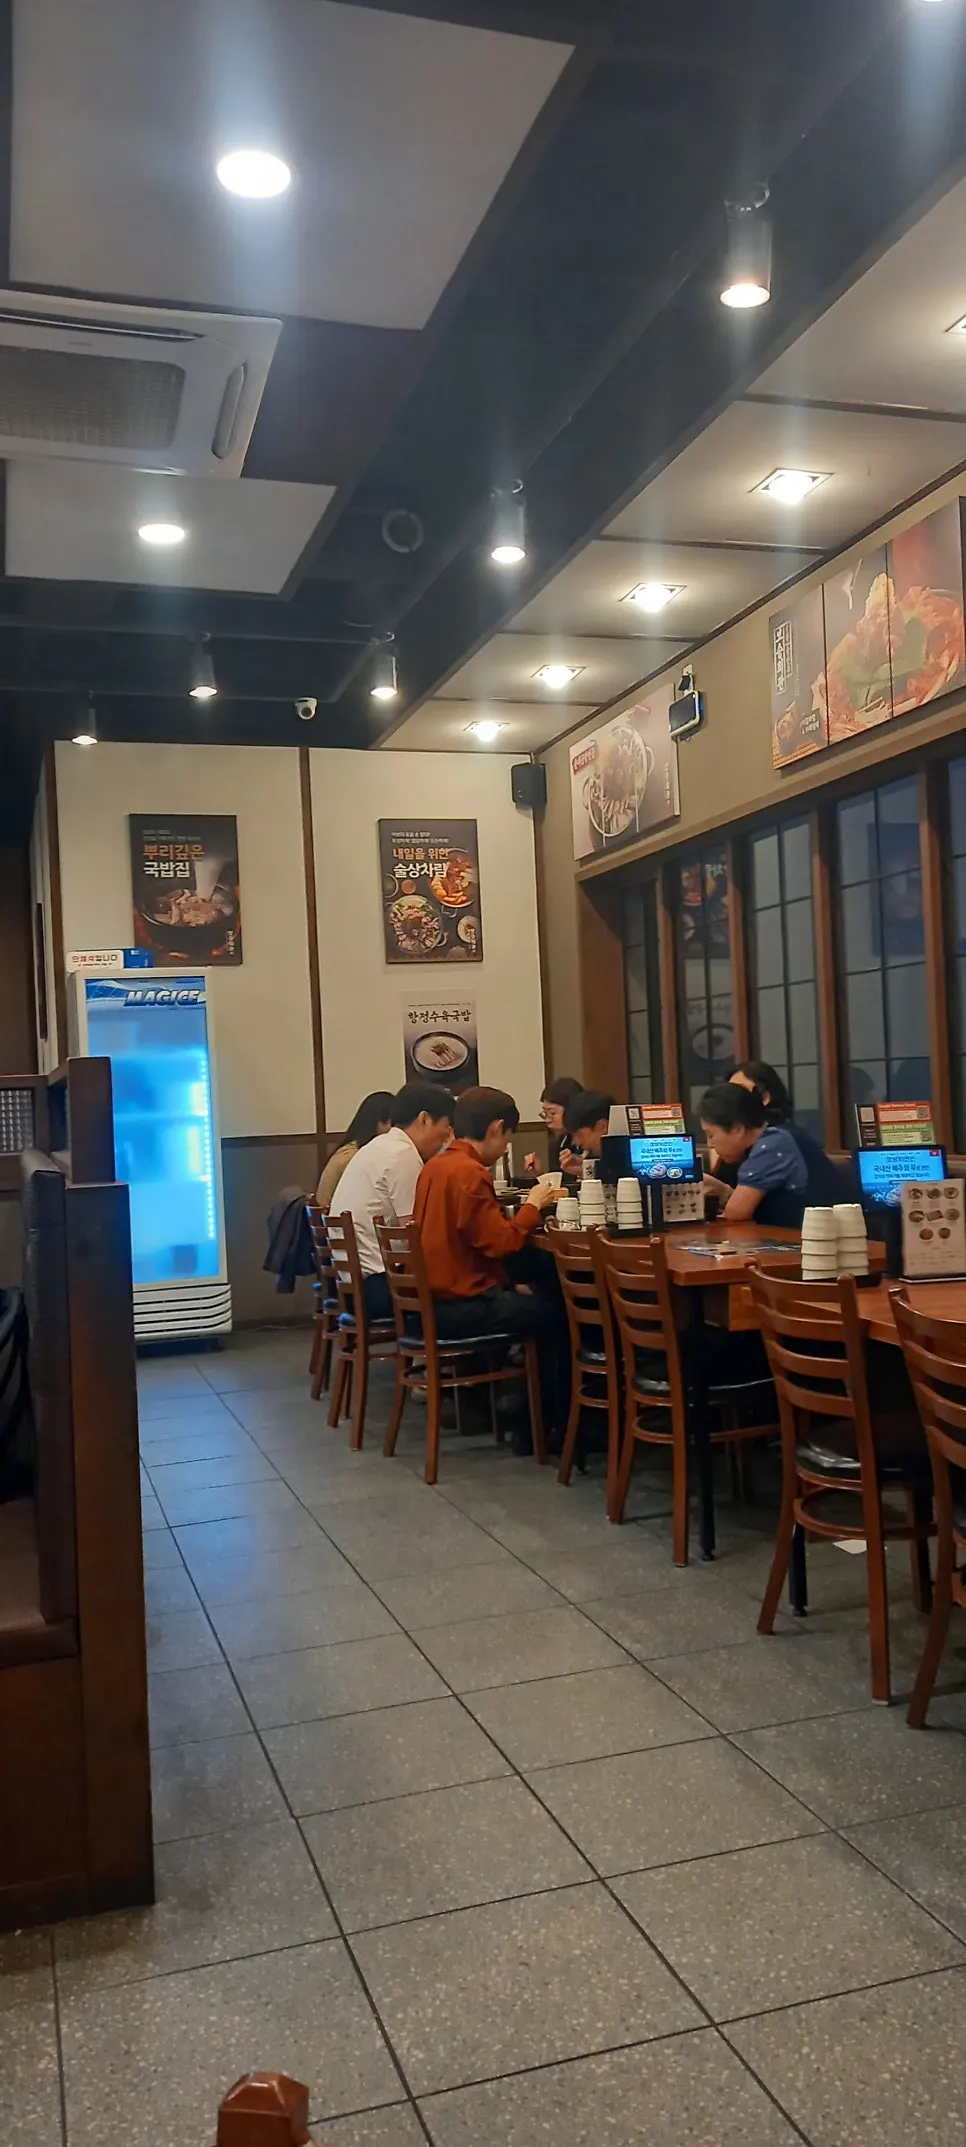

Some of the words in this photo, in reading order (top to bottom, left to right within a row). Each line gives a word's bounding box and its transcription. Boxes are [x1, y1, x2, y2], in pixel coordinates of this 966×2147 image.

[143, 844, 205, 861] 뿌리깊은
[393, 848, 425, 860] 내일을
[428, 848, 449, 860] 위한
[143, 862, 190, 878] 국밥집
[393, 862, 448, 878] 술상차림
[123, 989, 200, 1007] MAGICE
